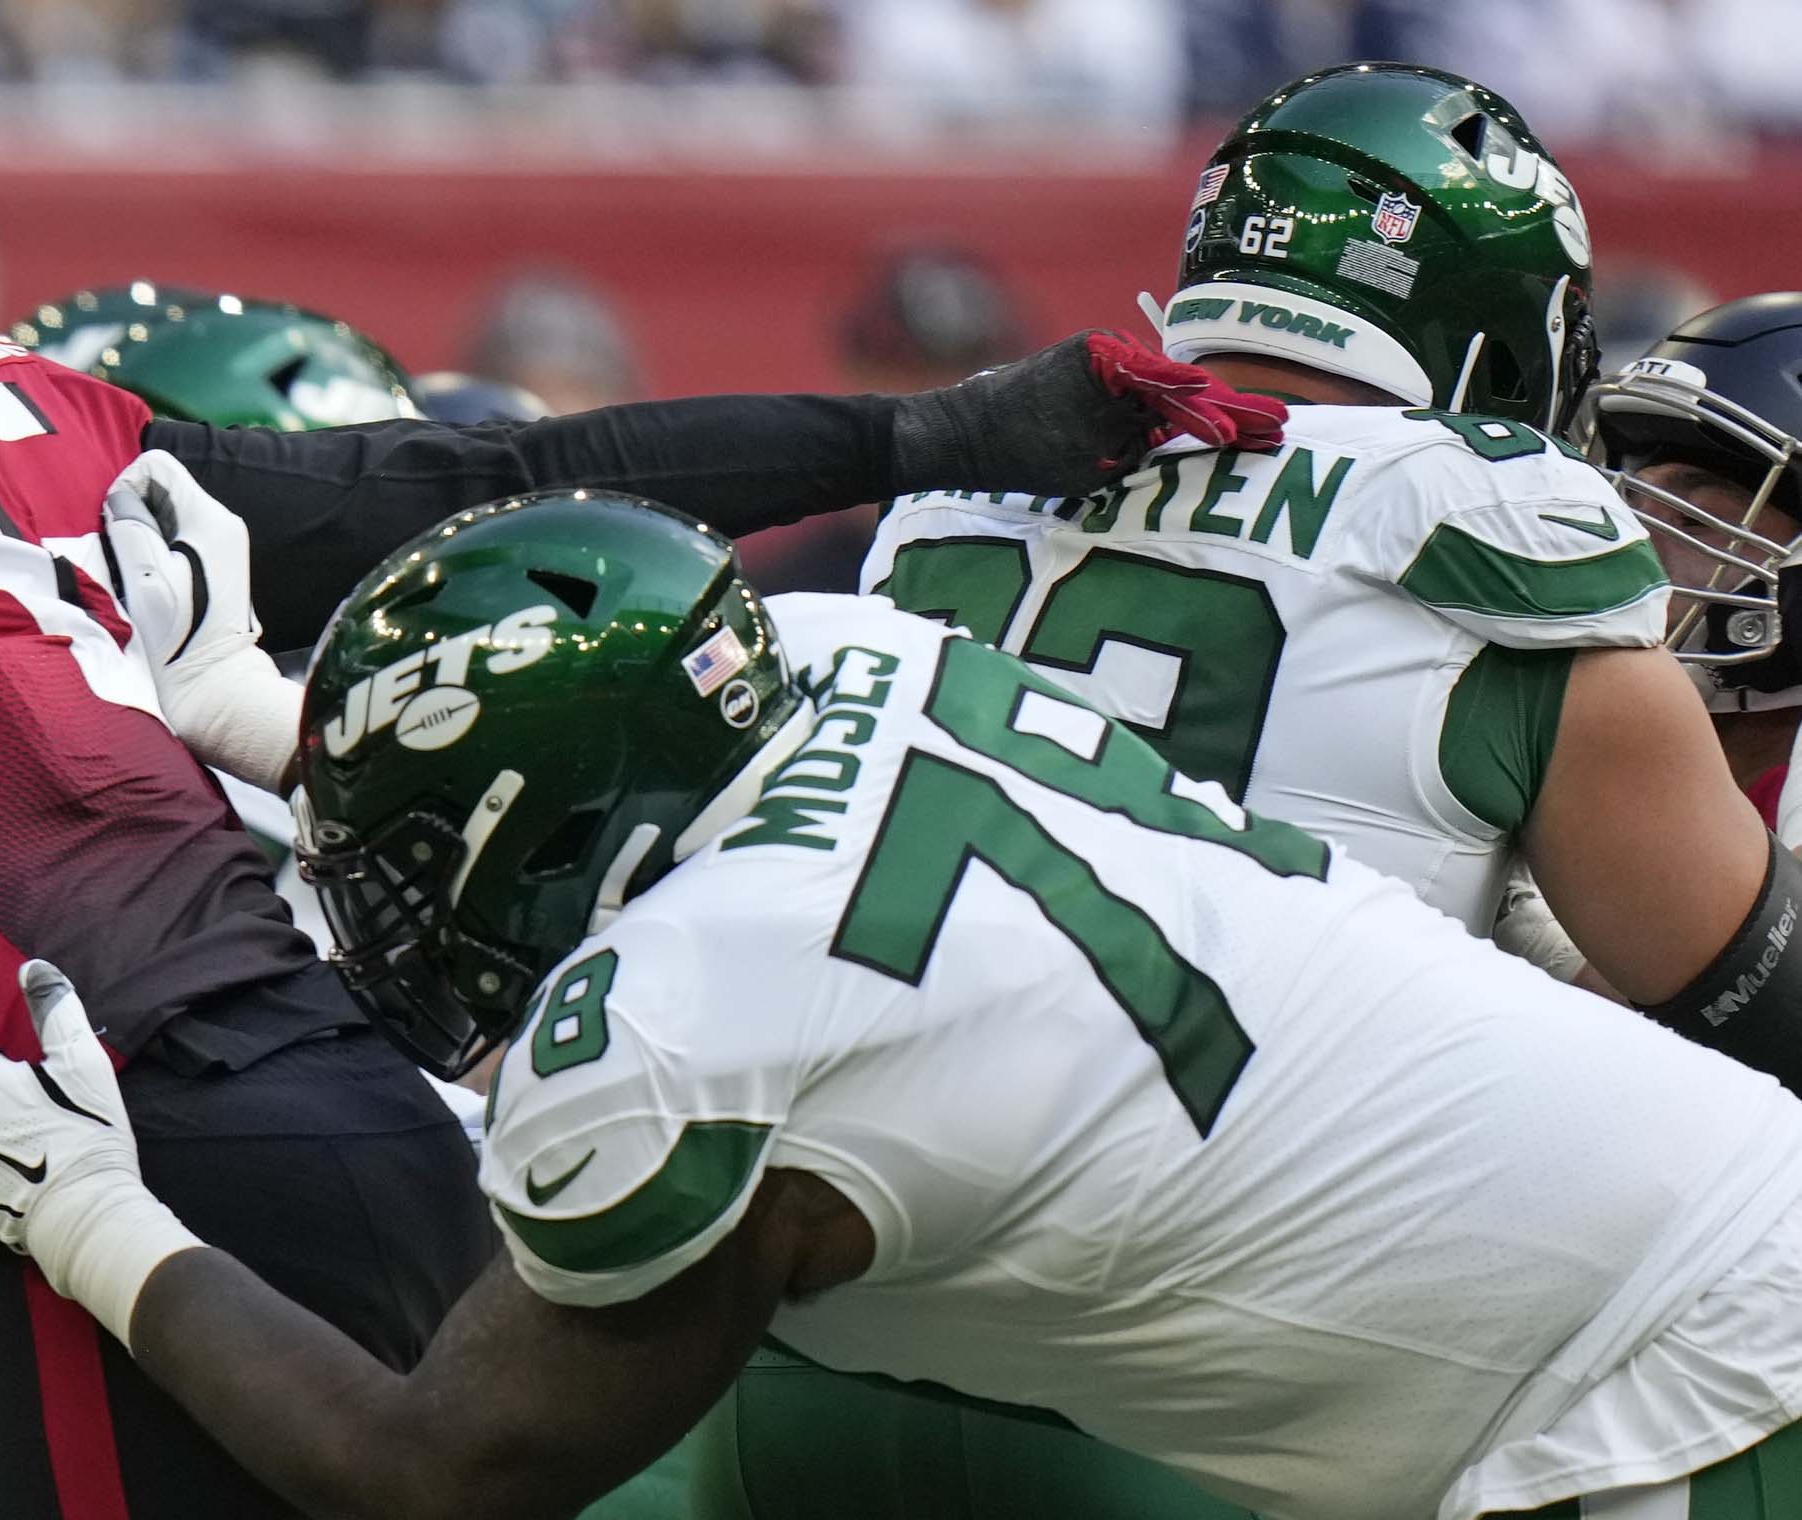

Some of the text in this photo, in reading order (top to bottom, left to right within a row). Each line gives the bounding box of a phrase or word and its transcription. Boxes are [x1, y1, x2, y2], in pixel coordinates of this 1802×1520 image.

[1239, 215, 1295, 259] 62
[1166, 297, 1357, 349] NEW YORK
[324, 604, 558, 758] JETS
[828, 634, 1333, 1141] 78
[1715, 897, 1799, 1012] Mueller
